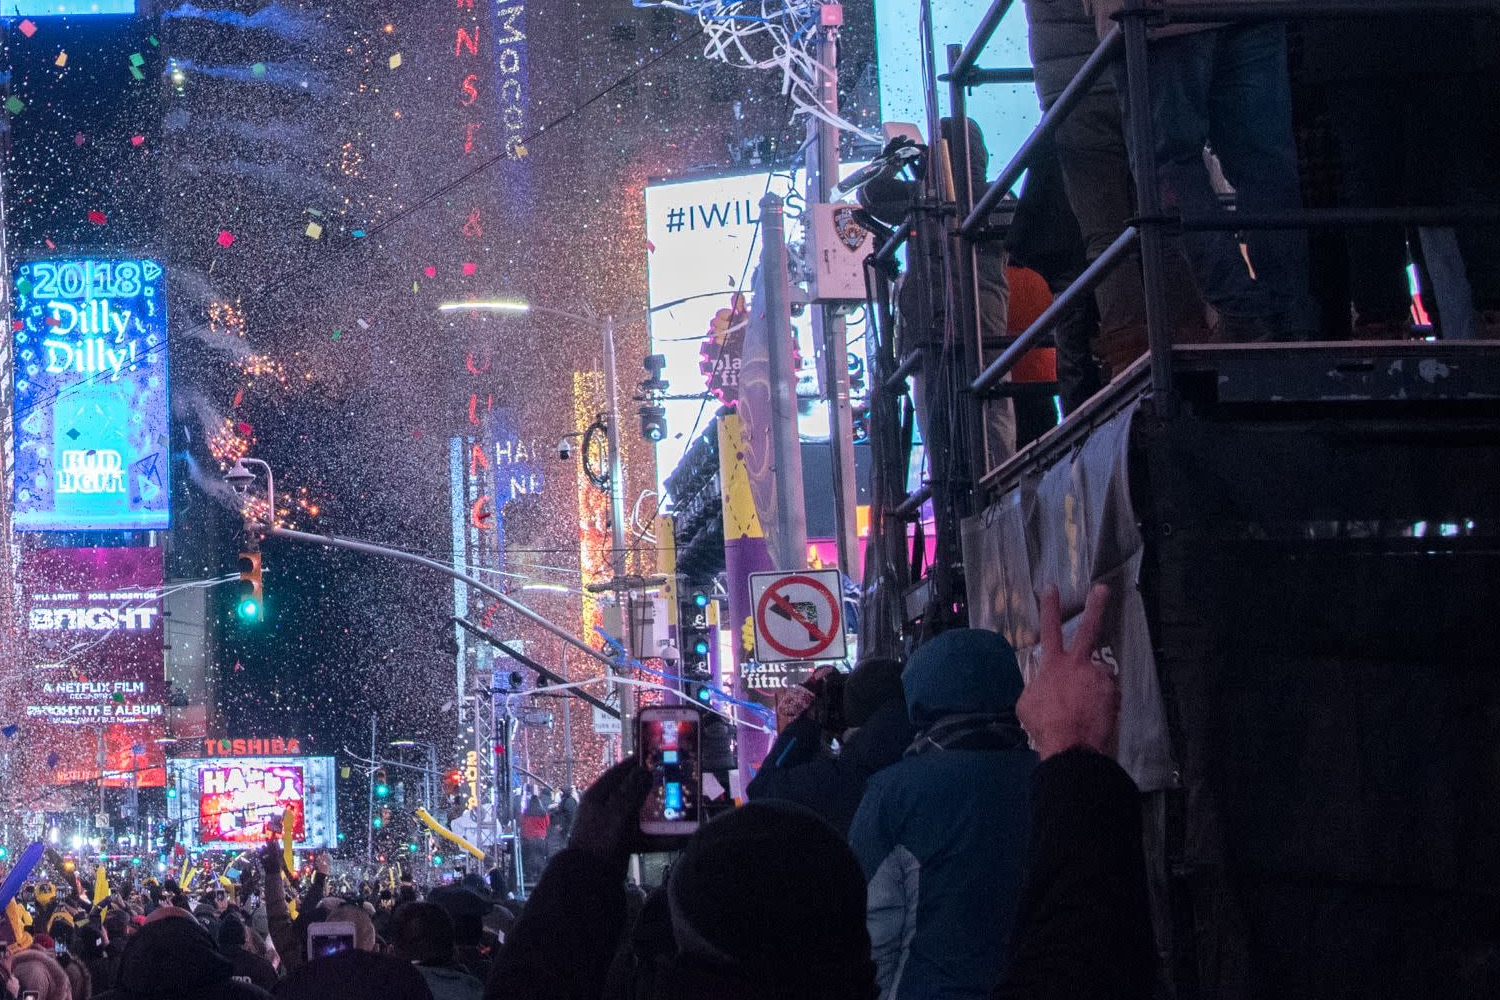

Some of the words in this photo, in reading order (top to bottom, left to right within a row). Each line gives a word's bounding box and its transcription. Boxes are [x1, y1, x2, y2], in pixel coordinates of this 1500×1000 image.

[32, 262, 141, 299] 2018
[47, 299, 132, 344] Dilly
[42, 339, 138, 382] Dilly!
[28, 607, 158, 630] BRIGHT
[56, 682, 111, 693] NETFLIX
[113, 681, 144, 693] FILM
[114, 704, 162, 716] ALBUM
[204, 738, 301, 756] TOSHIBA
